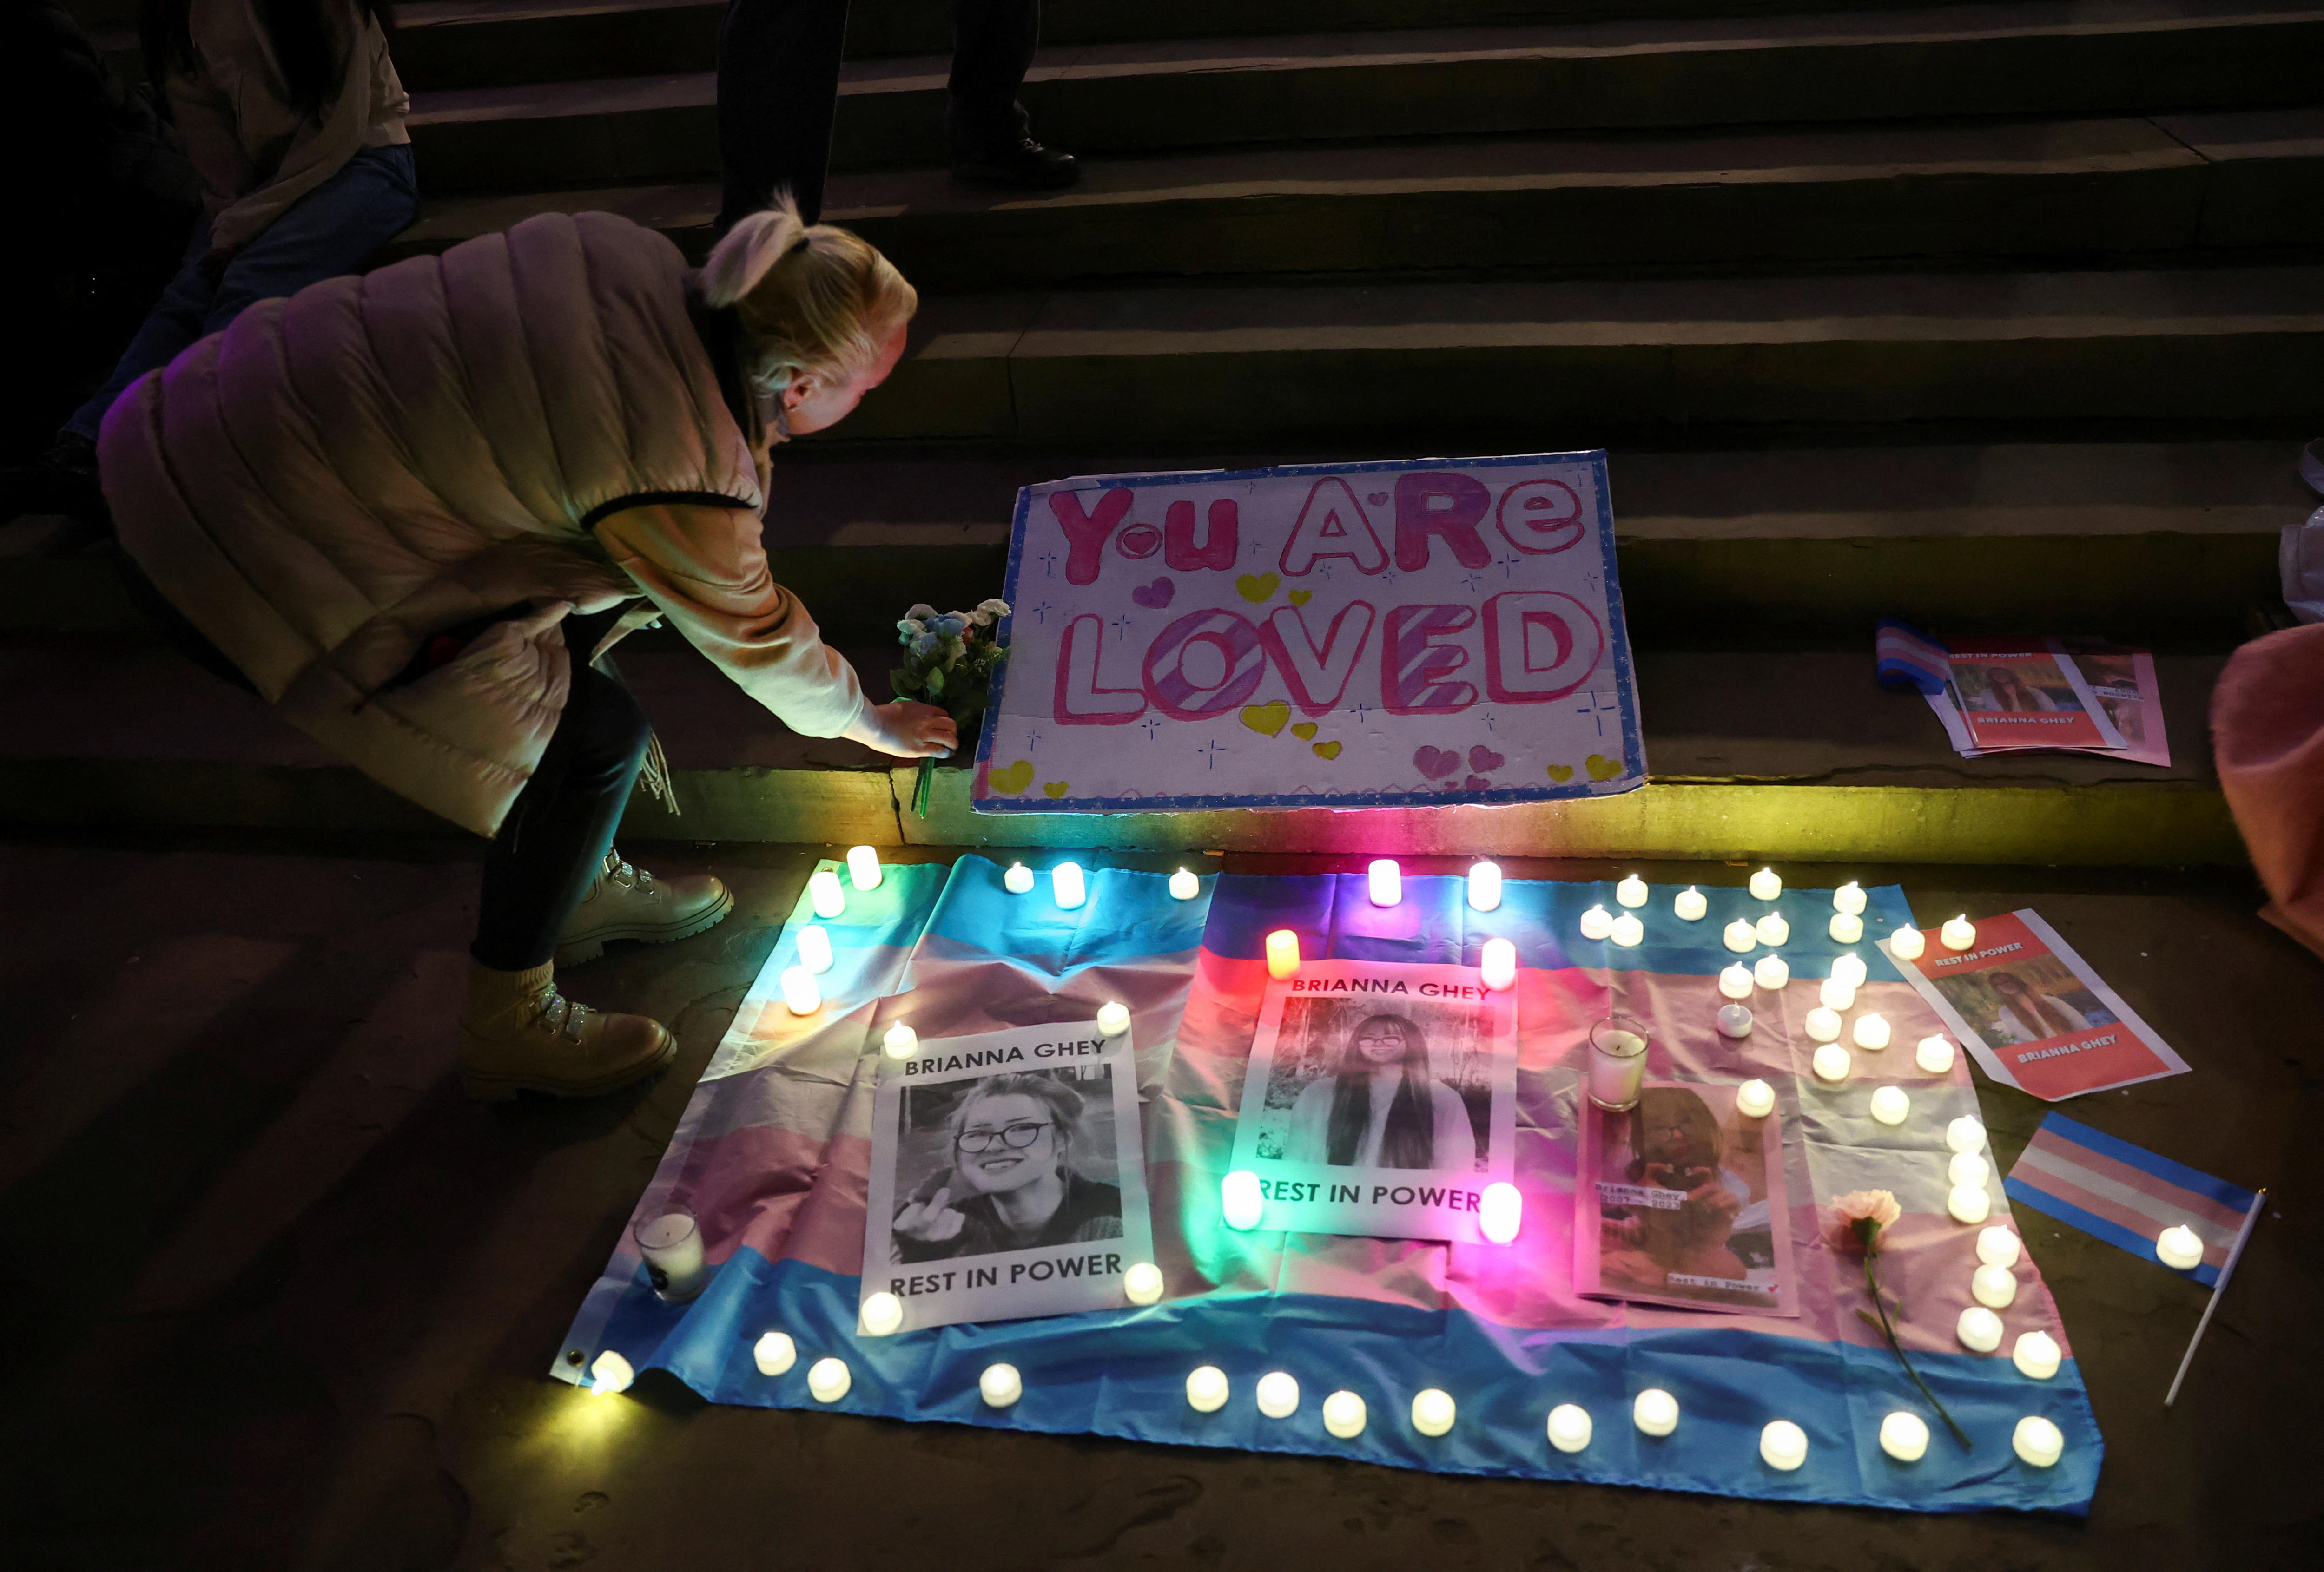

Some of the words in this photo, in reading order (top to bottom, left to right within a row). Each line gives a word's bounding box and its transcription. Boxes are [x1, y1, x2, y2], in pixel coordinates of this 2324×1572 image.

[1054, 590, 1604, 725] LOVED
[1935, 955, 1963, 967] REST
[1963, 952, 1979, 961] IN
[1979, 942, 2023, 958] POWER
[1292, 978, 1410, 995] BRIANNA
[1419, 983, 1491, 1000] GHEY
[905, 1046, 1025, 1076] BRIANNA
[1034, 1039, 1106, 1058] GHEY
[2017, 1043, 2081, 1063] BRIANNA
[2080, 1034, 2117, 1050] GHEY
[1260, 1179, 1320, 1202] REST
[1329, 1184, 1360, 1204] IN
[1373, 1186, 1481, 1213] POWER
[890, 1272, 957, 1297] REST
[967, 1267, 997, 1289] IN
[1010, 1254, 1122, 1283] POWER
